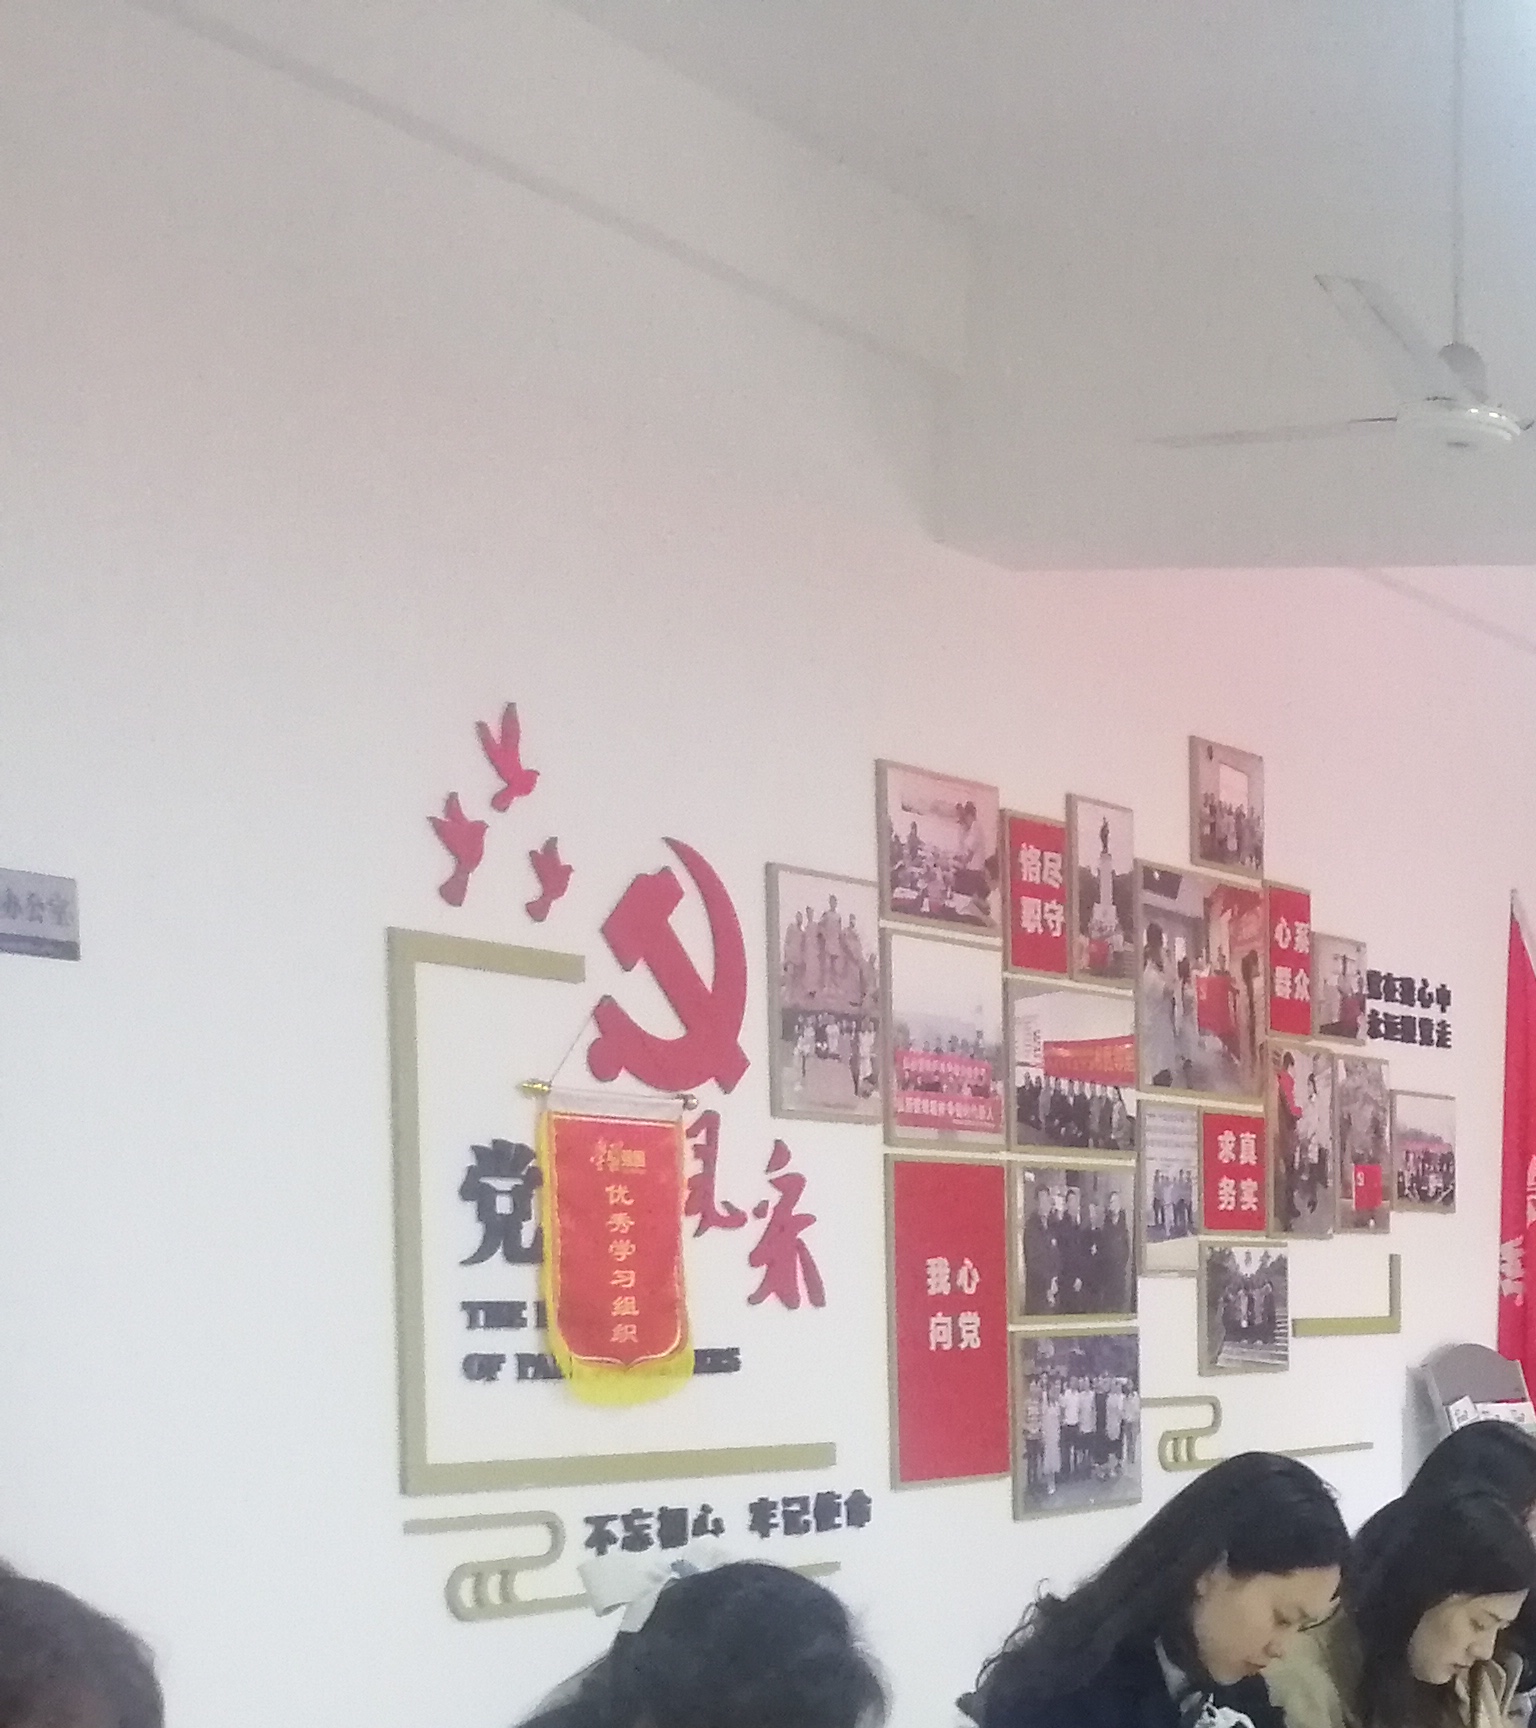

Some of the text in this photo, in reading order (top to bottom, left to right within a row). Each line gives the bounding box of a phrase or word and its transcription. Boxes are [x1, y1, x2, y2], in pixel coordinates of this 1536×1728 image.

[1216, 1129, 1258, 1166] 求真
[1217, 1176, 1258, 1213] 务实
[606, 1184, 640, 1343] 优秀学习组织
[926, 1256, 980, 1295] 我心
[929, 1311, 981, 1351] 向党
[584, 1489, 872, 1556] 不忘初心 牢记使命
